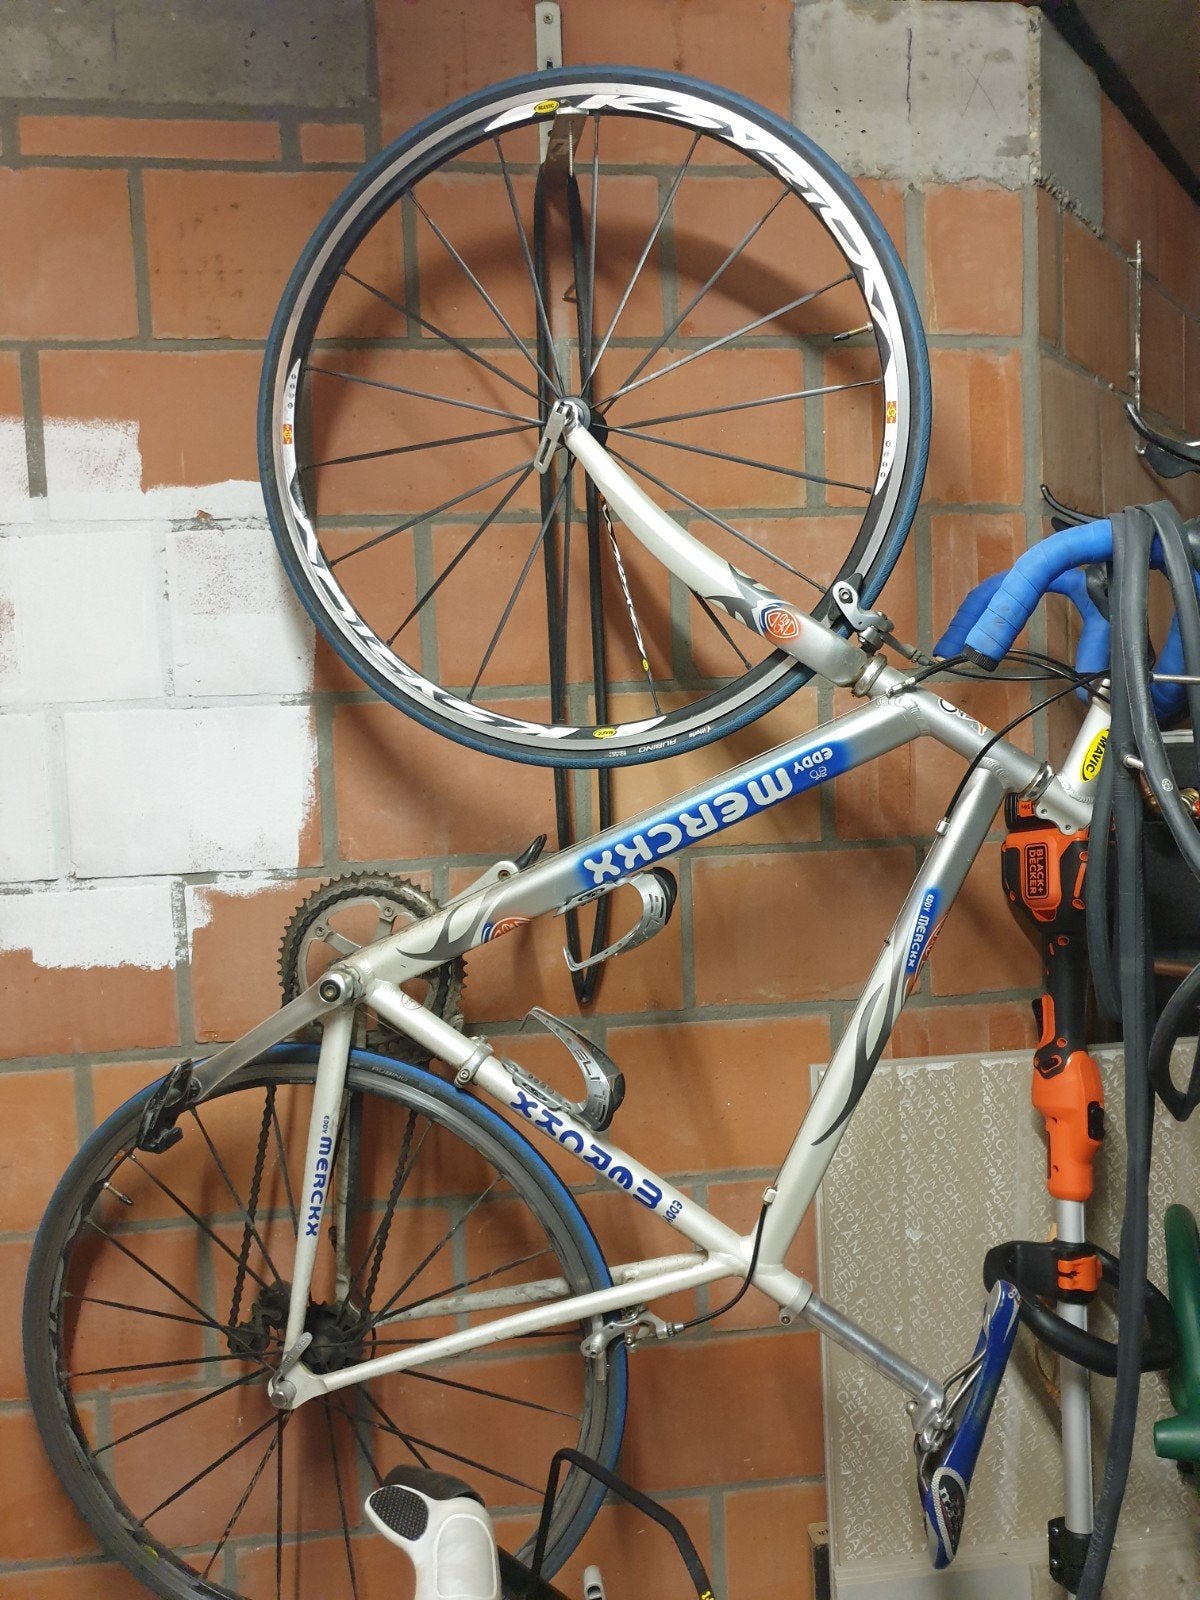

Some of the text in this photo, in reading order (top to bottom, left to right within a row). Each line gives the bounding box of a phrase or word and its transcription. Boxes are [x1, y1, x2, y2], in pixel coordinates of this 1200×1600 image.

[638, 739, 677, 754] RUBINO
[1086, 735, 1108, 773] MAVIC
[583, 747, 833, 884] EDDY MERCKX
[1028, 849, 1037, 894] DECKER
[1036, 848, 1045, 893] BLACK+
[907, 893, 934, 968] EDDY MERCKX
[306, 1115, 332, 1237] EDDY MERCKX
[510, 1091, 683, 1224] EDDY MERCKX
[941, 1180, 978, 1229] GRES
[839, 1442, 864, 1474] GRES
[846, 1430, 871, 1462] ITALY
